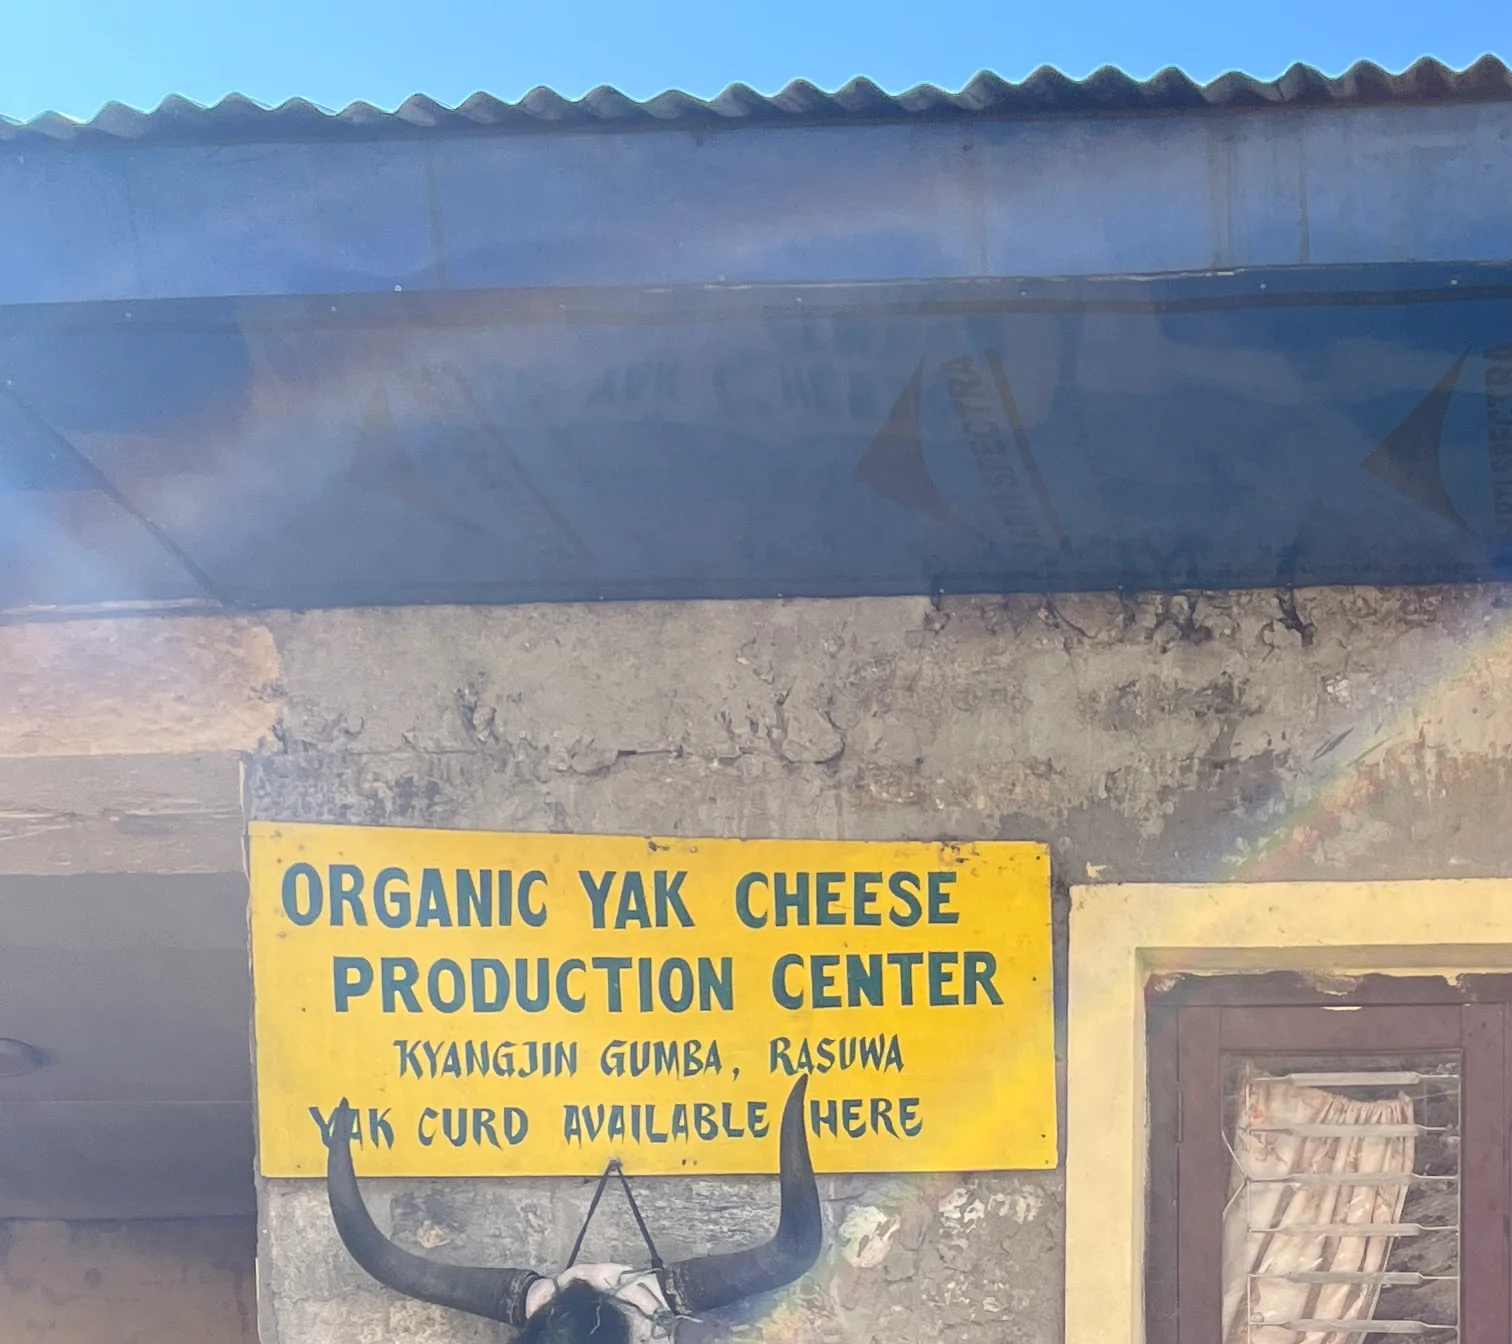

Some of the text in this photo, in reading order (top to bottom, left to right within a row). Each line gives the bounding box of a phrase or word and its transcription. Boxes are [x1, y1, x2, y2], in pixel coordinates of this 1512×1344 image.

[280, 863, 959, 929] ORGANIC YAK CHEESE
[333, 951, 1004, 1014] PRODUCTION CENTER
[393, 1033, 904, 1082] KYANGJIN GUMBA, RASUWA
[418, 1106, 528, 1146] CURD
[563, 1100, 769, 1146] AVAILABLE
[812, 1096, 923, 1138] HERE
